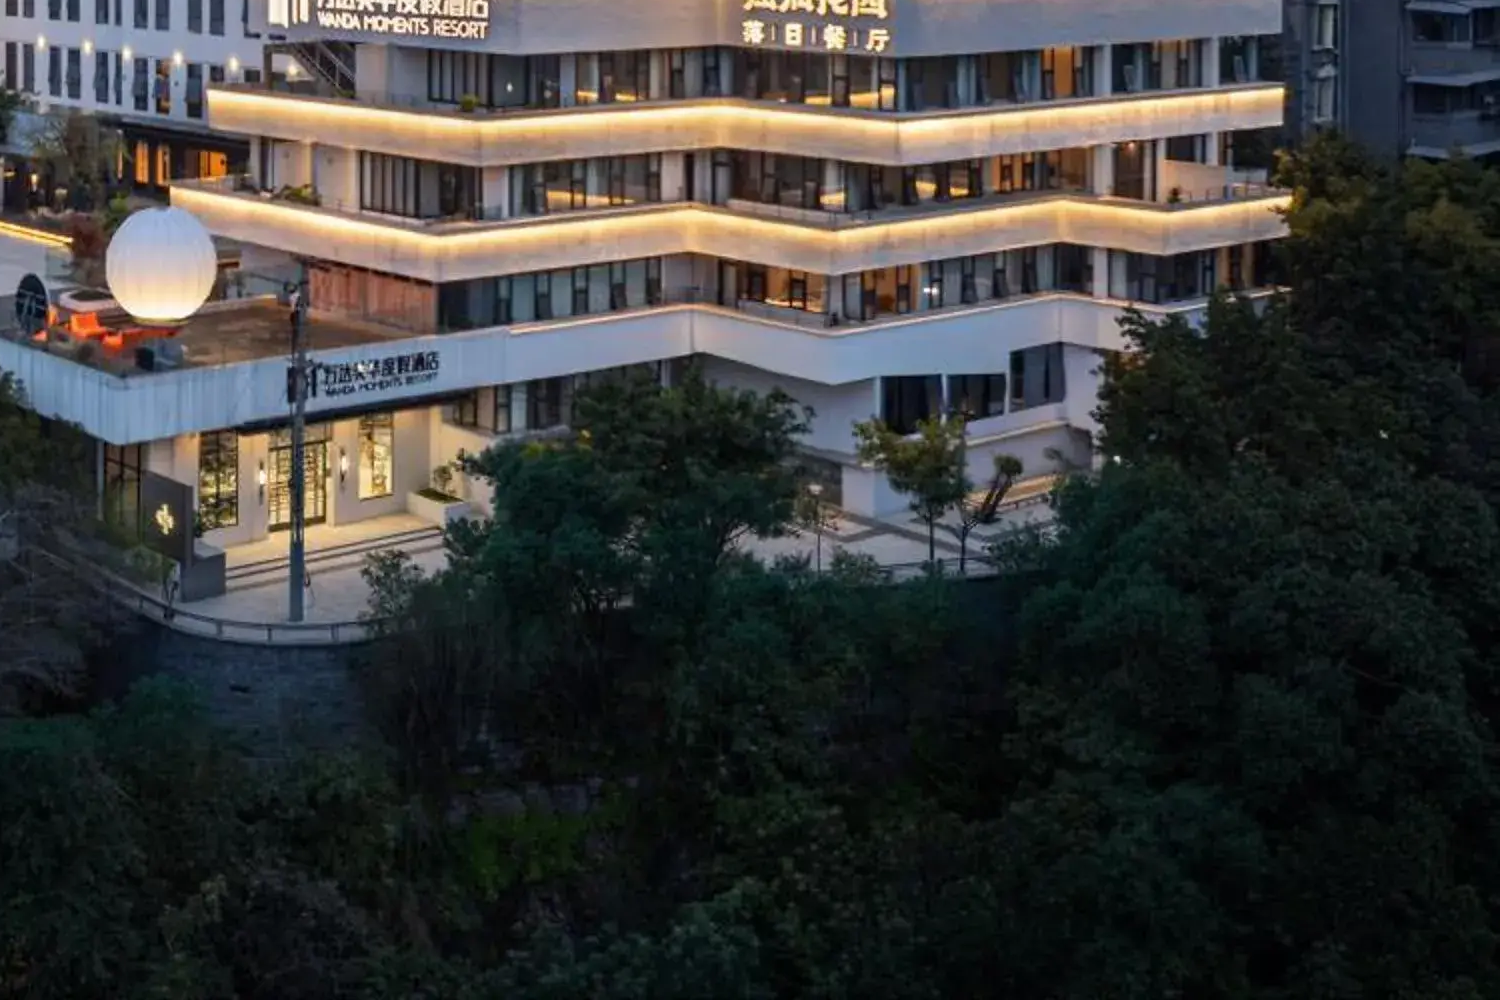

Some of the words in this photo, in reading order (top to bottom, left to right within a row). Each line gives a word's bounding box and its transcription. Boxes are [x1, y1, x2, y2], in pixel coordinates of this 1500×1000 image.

[317, 11, 361, 30] WANDA
[364, 14, 429, 35] MOMENTS
[433, 19, 489, 39] RESORT
